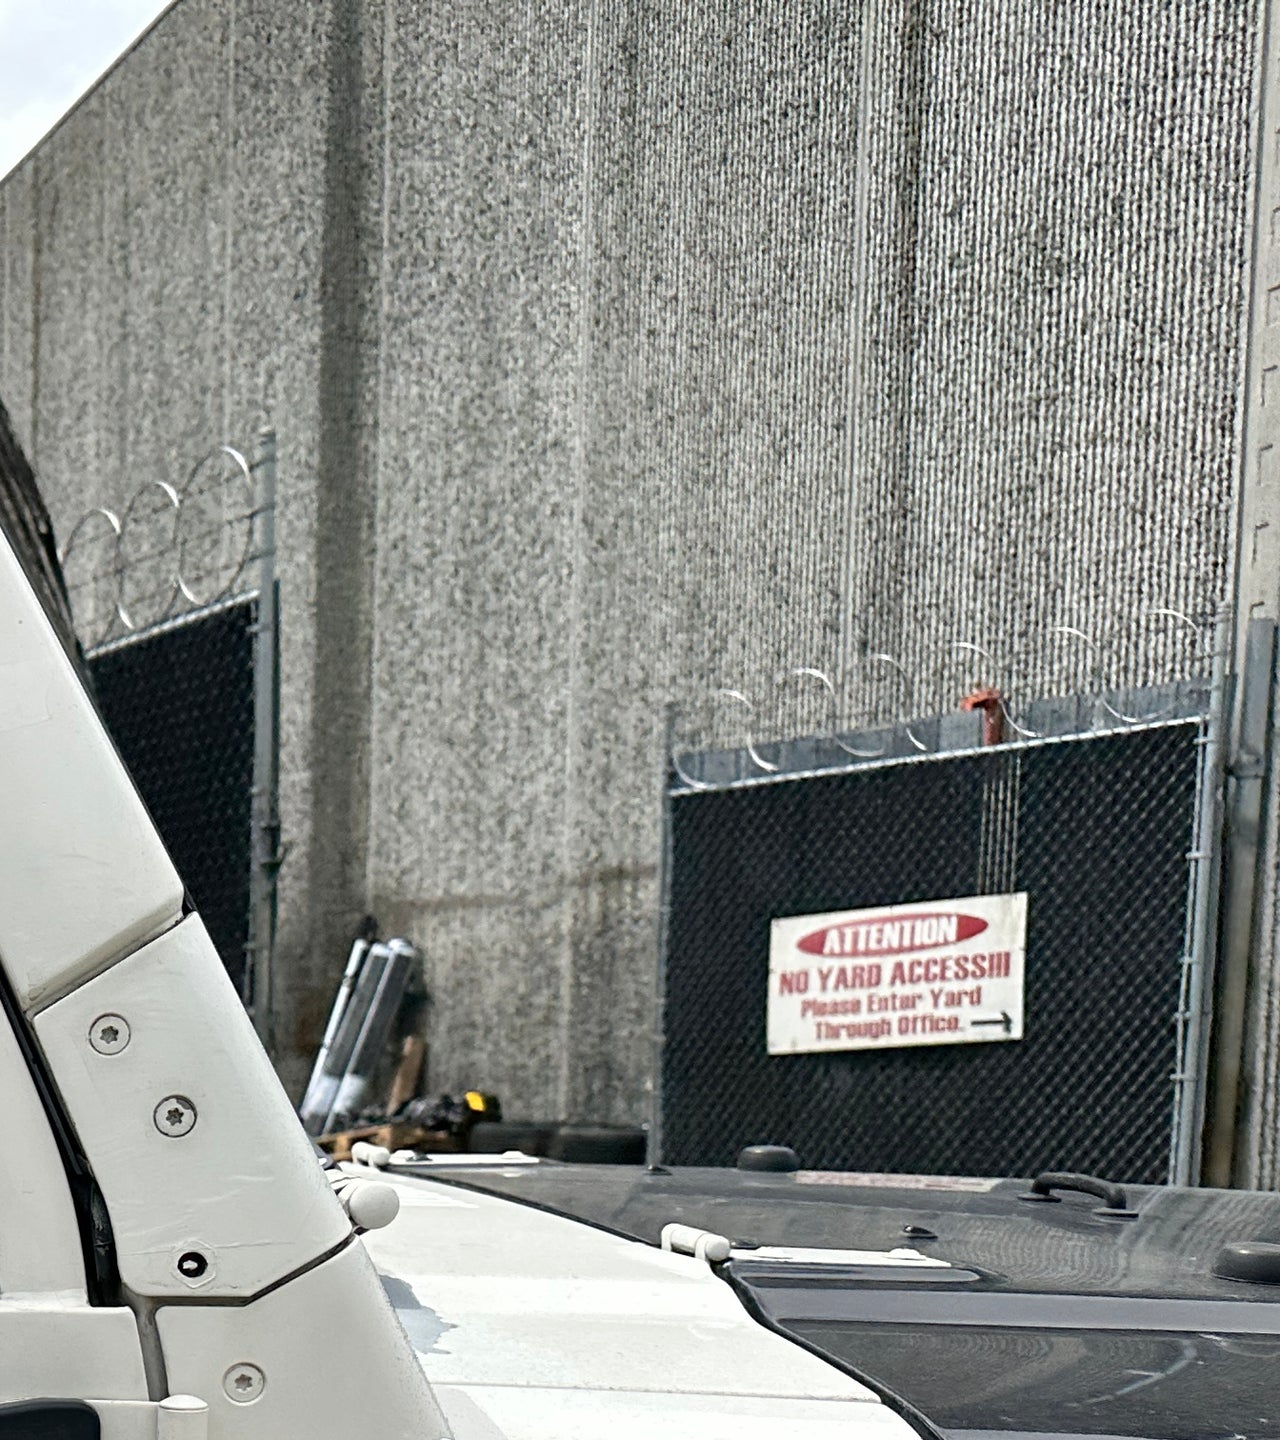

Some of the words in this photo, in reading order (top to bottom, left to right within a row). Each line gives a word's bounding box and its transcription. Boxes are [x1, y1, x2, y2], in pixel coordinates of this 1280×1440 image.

[822, 915, 959, 954] ATTENTION
[779, 970, 809, 996] NO
[817, 964, 882, 992] YARD
[800, 998, 861, 1019] Please
[867, 990, 923, 1013] Enter
[930, 984, 983, 1008] Yard
[816, 1018, 892, 1039] Through
